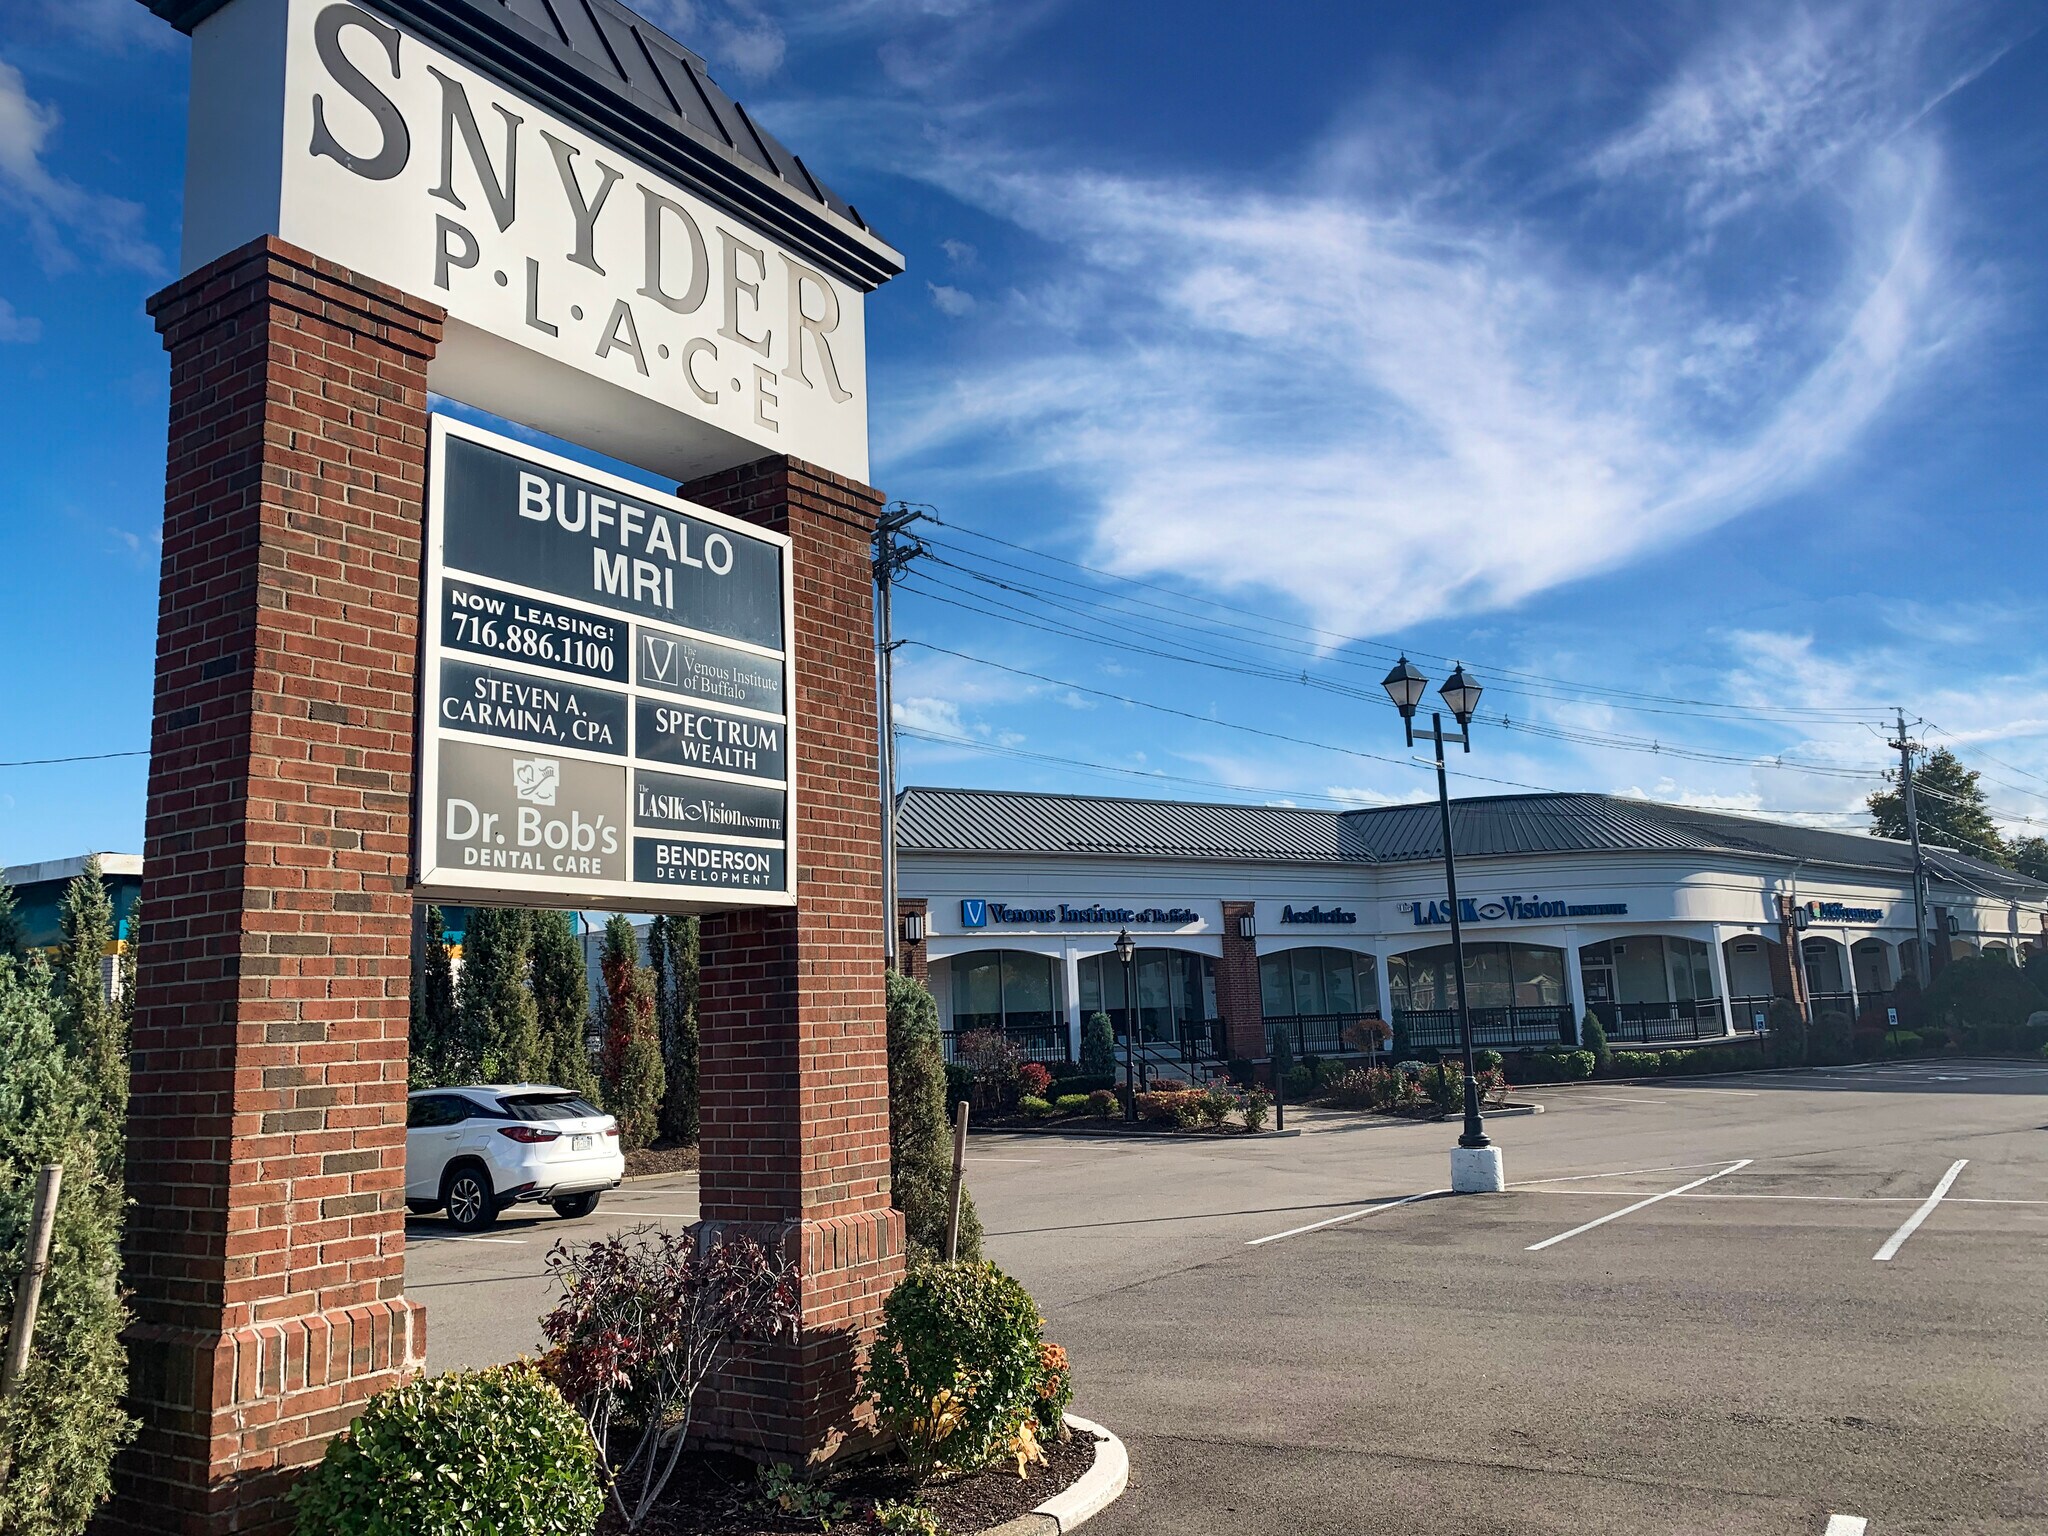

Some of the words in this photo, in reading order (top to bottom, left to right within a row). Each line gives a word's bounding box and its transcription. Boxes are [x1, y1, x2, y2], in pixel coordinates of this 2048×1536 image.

[309, 4, 852, 403] SNYDER
[519, 471, 733, 575] BUFFALO
[594, 547, 674, 609] MRI
[452, 590, 505, 615] NOW
[514, 605, 614, 641] LEASING!
[451, 612, 614, 672] 716.886.1100
[684, 656, 729, 680] Venous
[733, 667, 778, 691] Institute
[684, 675, 698, 690] of
[701, 677, 745, 700] Buffalo
[474, 677, 559, 712] STEVEN
[565, 695, 587, 717] A.
[572, 719, 613, 745] CPA
[655, 707, 777, 751] SPECTRUM
[681, 740, 756, 770] WEALTH
[446, 798, 505, 845] Dr.
[517, 806, 618, 854] Bob's
[639, 793, 685, 820] LASIK
[701, 800, 741, 826] Vision
[741, 815, 780, 830] INSTITUTE
[464, 847, 545, 871] DENTAL
[553, 854, 602, 875] CARE
[656, 844, 770, 873] BENDERSON
[656, 867, 770, 885] DEVELOPMENT
[987, 903, 1056, 923] Venous
[1058, 904, 1135, 923] Institute
[1135, 908, 1152, 922] of
[1501, 895, 1568, 920] Vision
